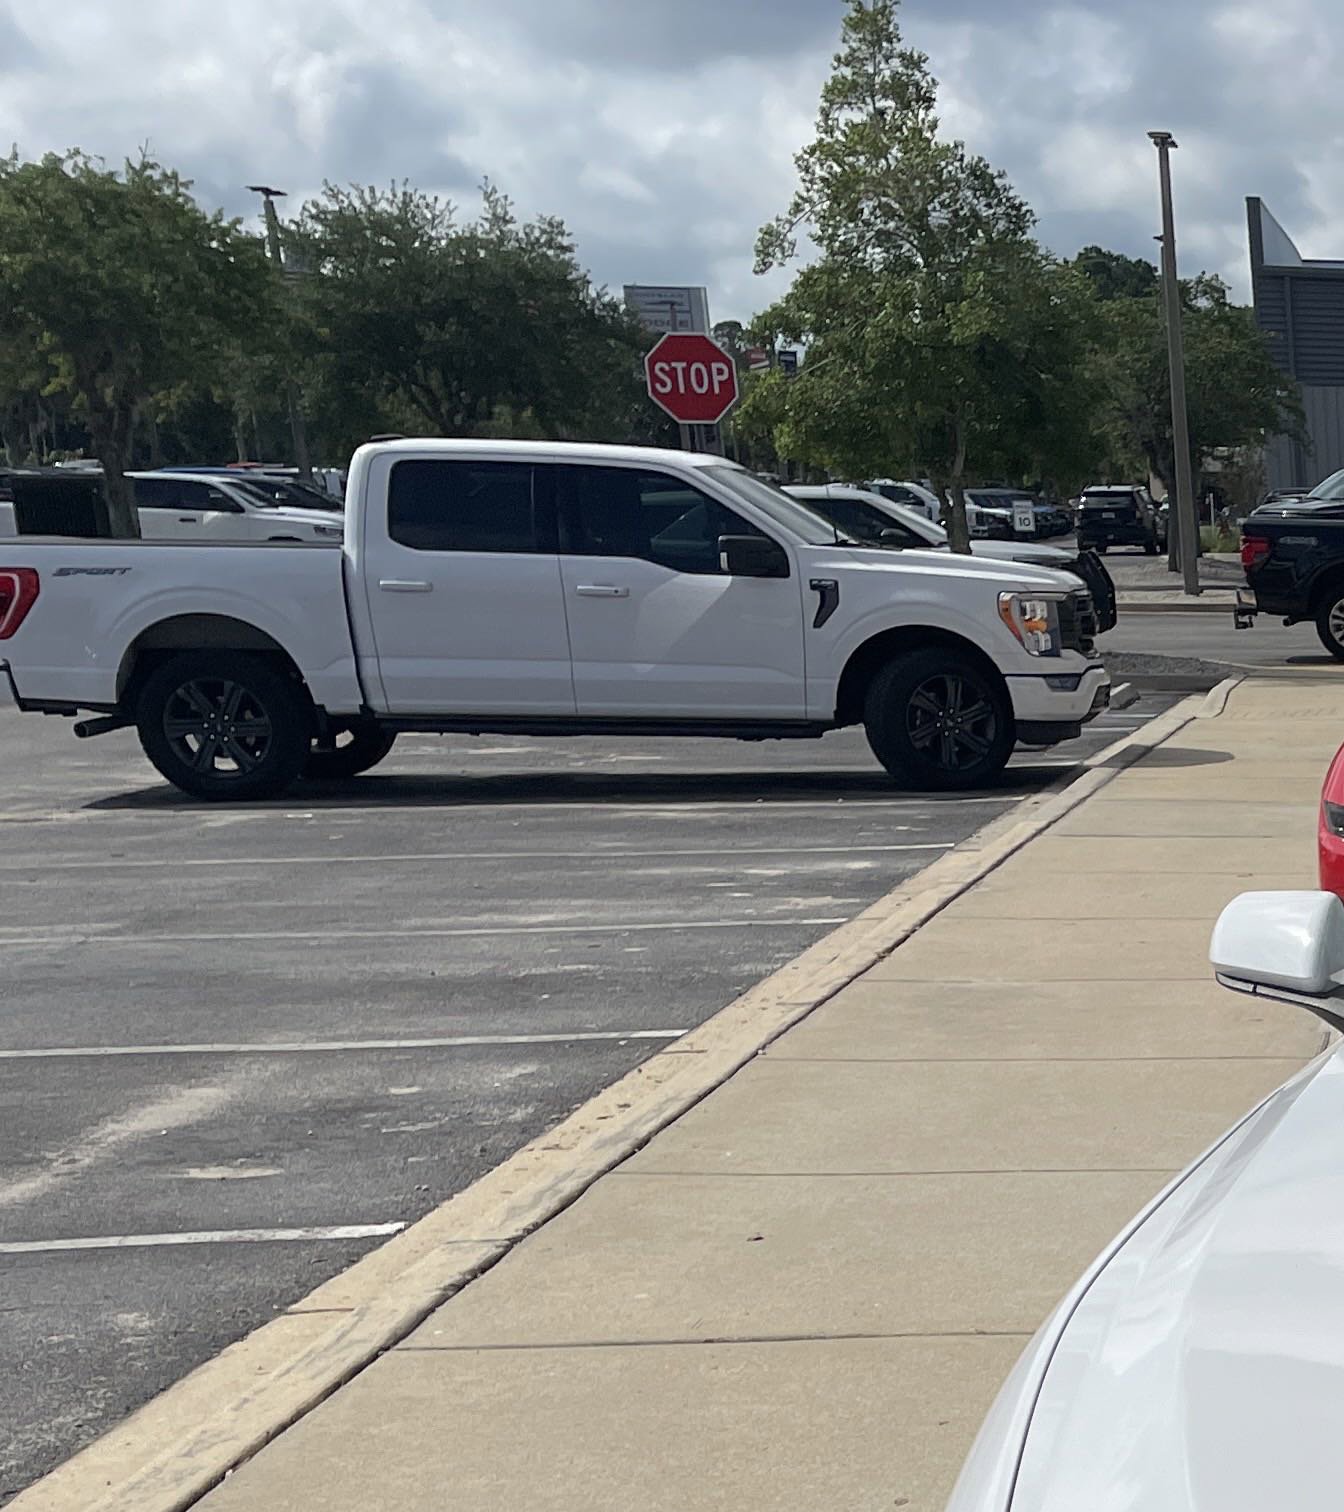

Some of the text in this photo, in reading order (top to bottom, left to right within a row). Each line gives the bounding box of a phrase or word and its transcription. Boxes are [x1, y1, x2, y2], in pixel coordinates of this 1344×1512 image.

[654, 362, 729, 394] STOP
[1018, 516, 1031, 527] 10
[52, 567, 132, 577] SPORT
